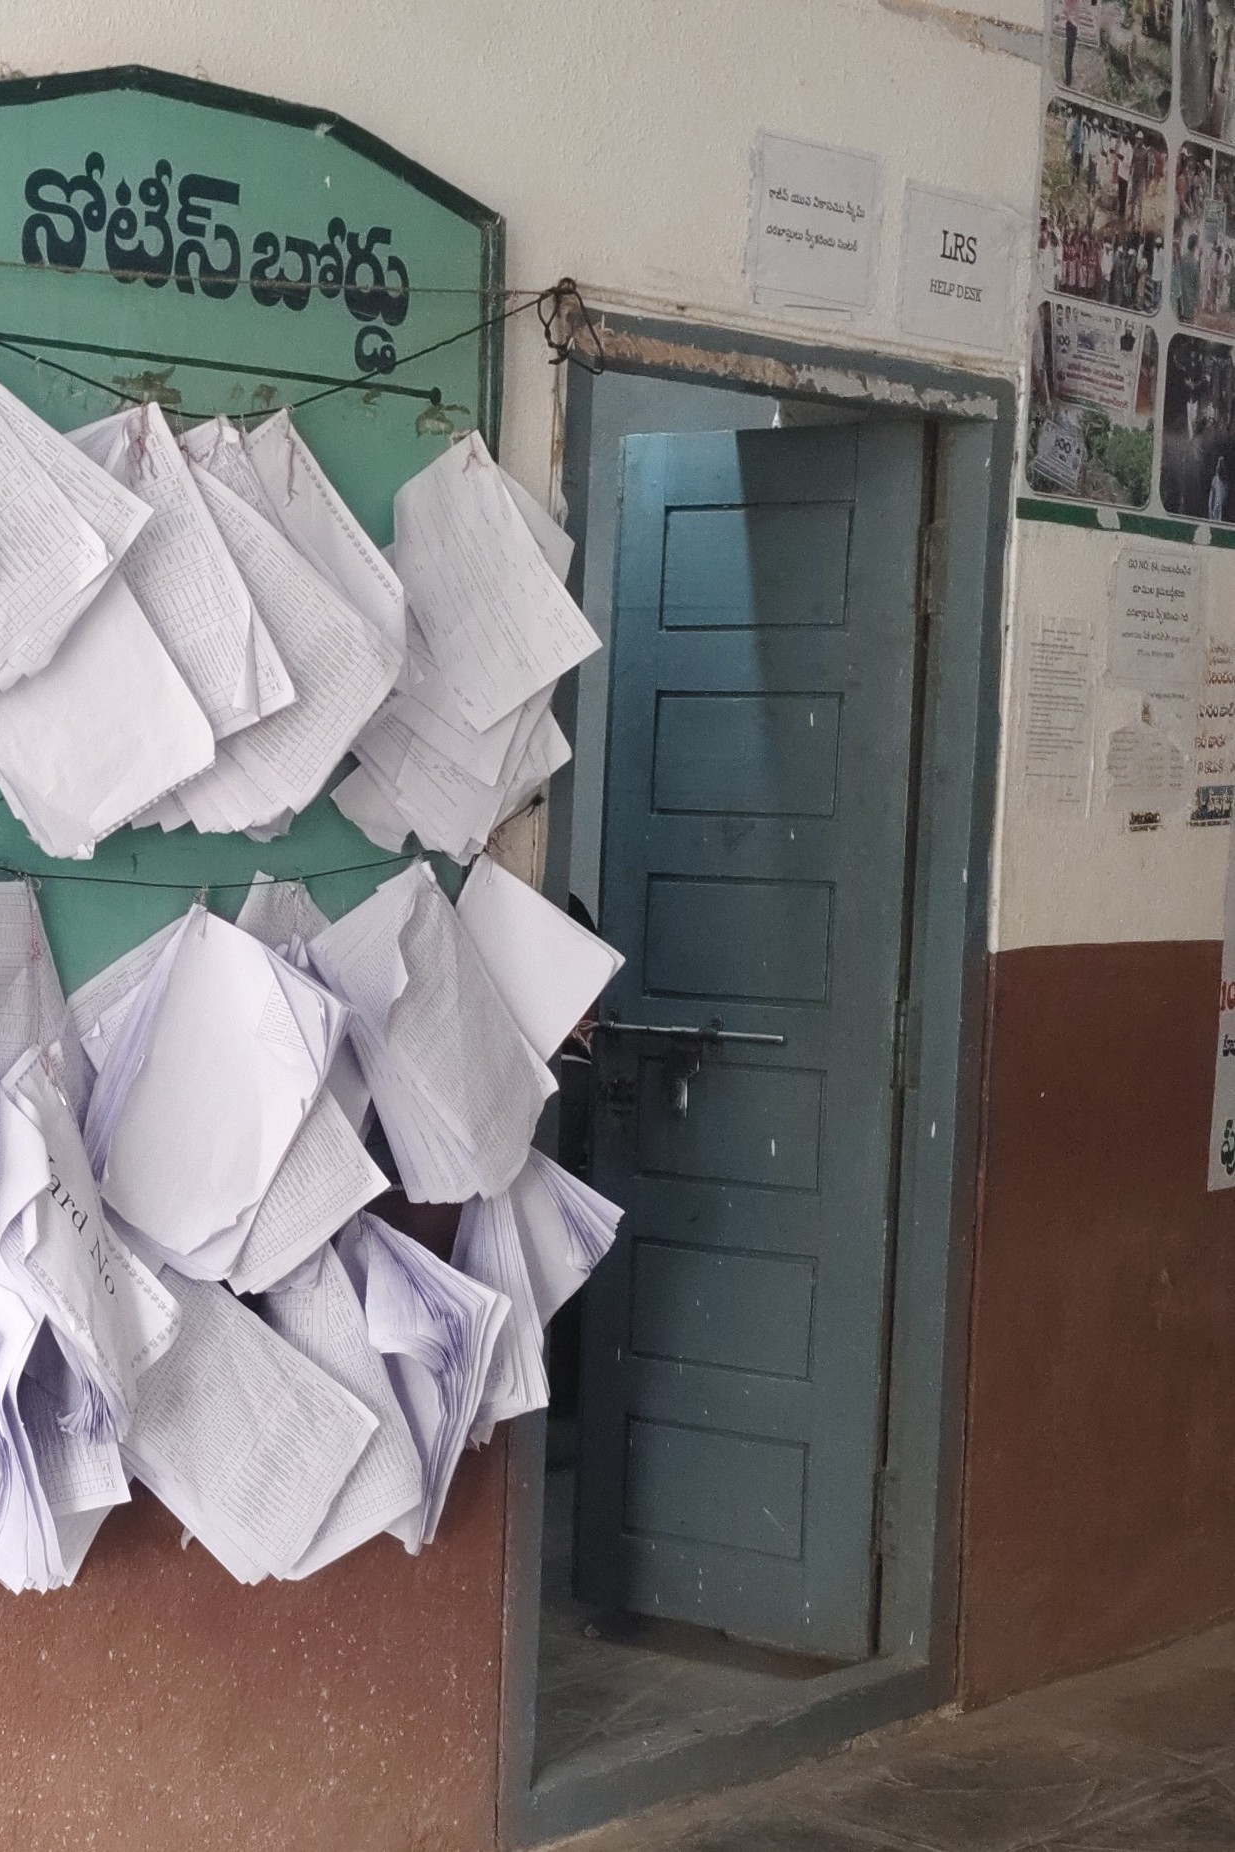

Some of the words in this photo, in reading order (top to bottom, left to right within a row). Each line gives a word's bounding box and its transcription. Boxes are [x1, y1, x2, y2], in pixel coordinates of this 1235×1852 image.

[940, 229, 977, 264] LRS
[930, 278, 955, 297] HELP
[956, 284, 983, 302] DESK
